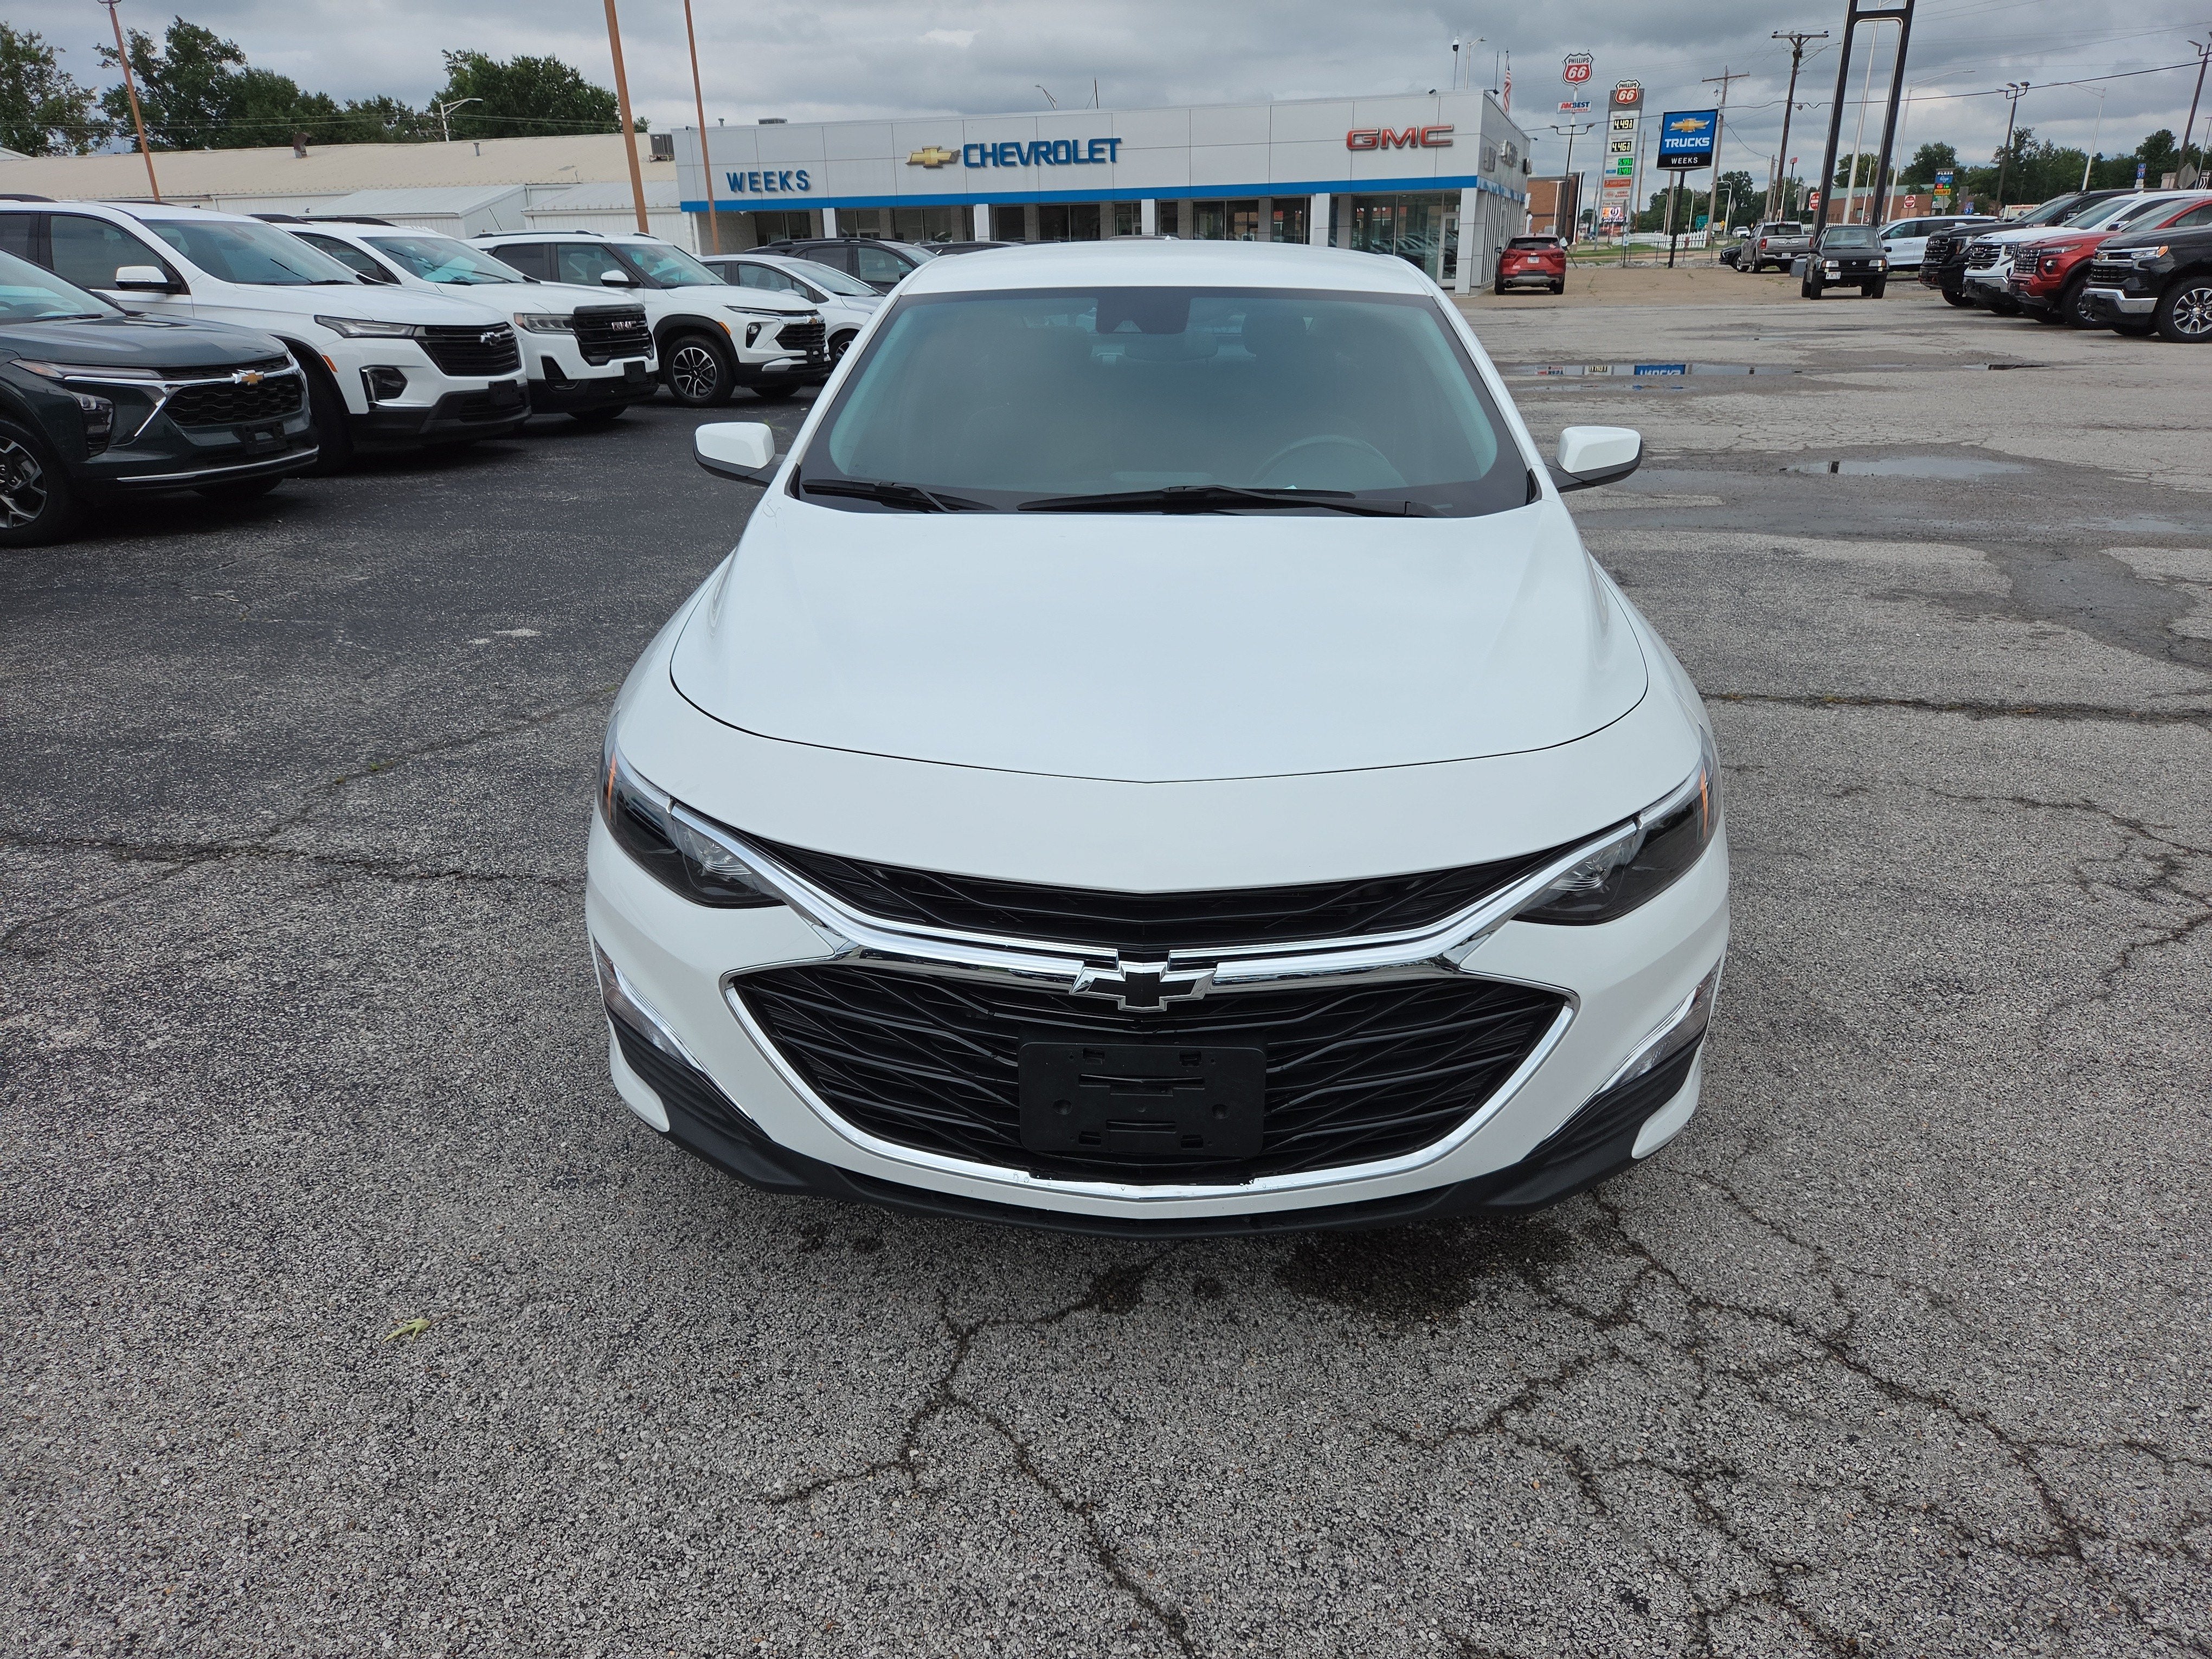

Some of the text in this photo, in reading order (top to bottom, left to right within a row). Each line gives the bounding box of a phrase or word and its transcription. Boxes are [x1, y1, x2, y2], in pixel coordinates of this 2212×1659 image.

[1568, 66, 1587, 79] 66
[1618, 89, 1635, 101] 66
[1346, 123, 1454, 151] GMC
[1664, 137, 1710, 148] TRUCKS
[963, 137, 1122, 168] CHEVROLET
[725, 169, 811, 192] WEEKS
